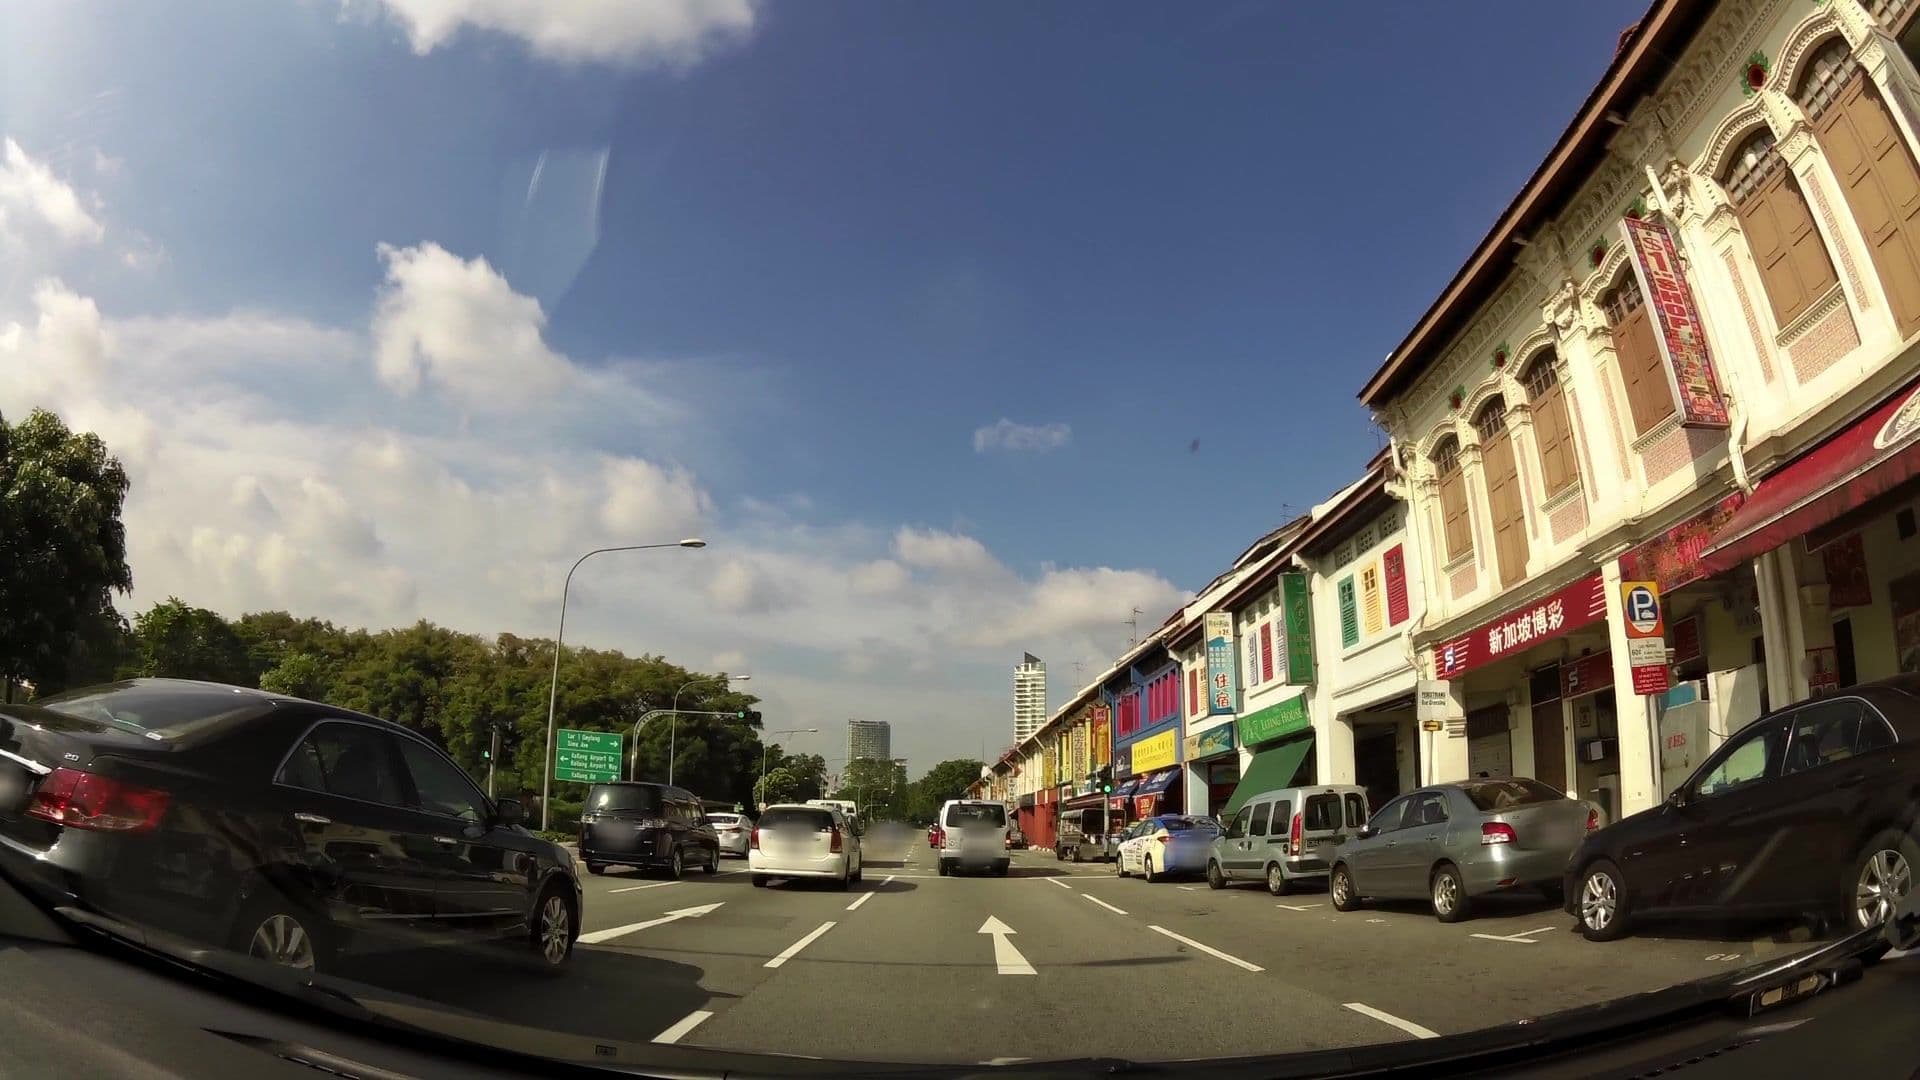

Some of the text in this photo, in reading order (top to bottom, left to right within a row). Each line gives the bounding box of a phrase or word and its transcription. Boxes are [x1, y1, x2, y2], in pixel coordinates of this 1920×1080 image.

[1656, 278, 1689, 329] SHOP
[1489, 599, 1564, 655] 新加坡博彩
[1214, 672, 1231, 708] 住宿
[582, 734, 600, 742] Geylang
[572, 772, 588, 780] Kallang
[589, 761, 606, 769] Airport
